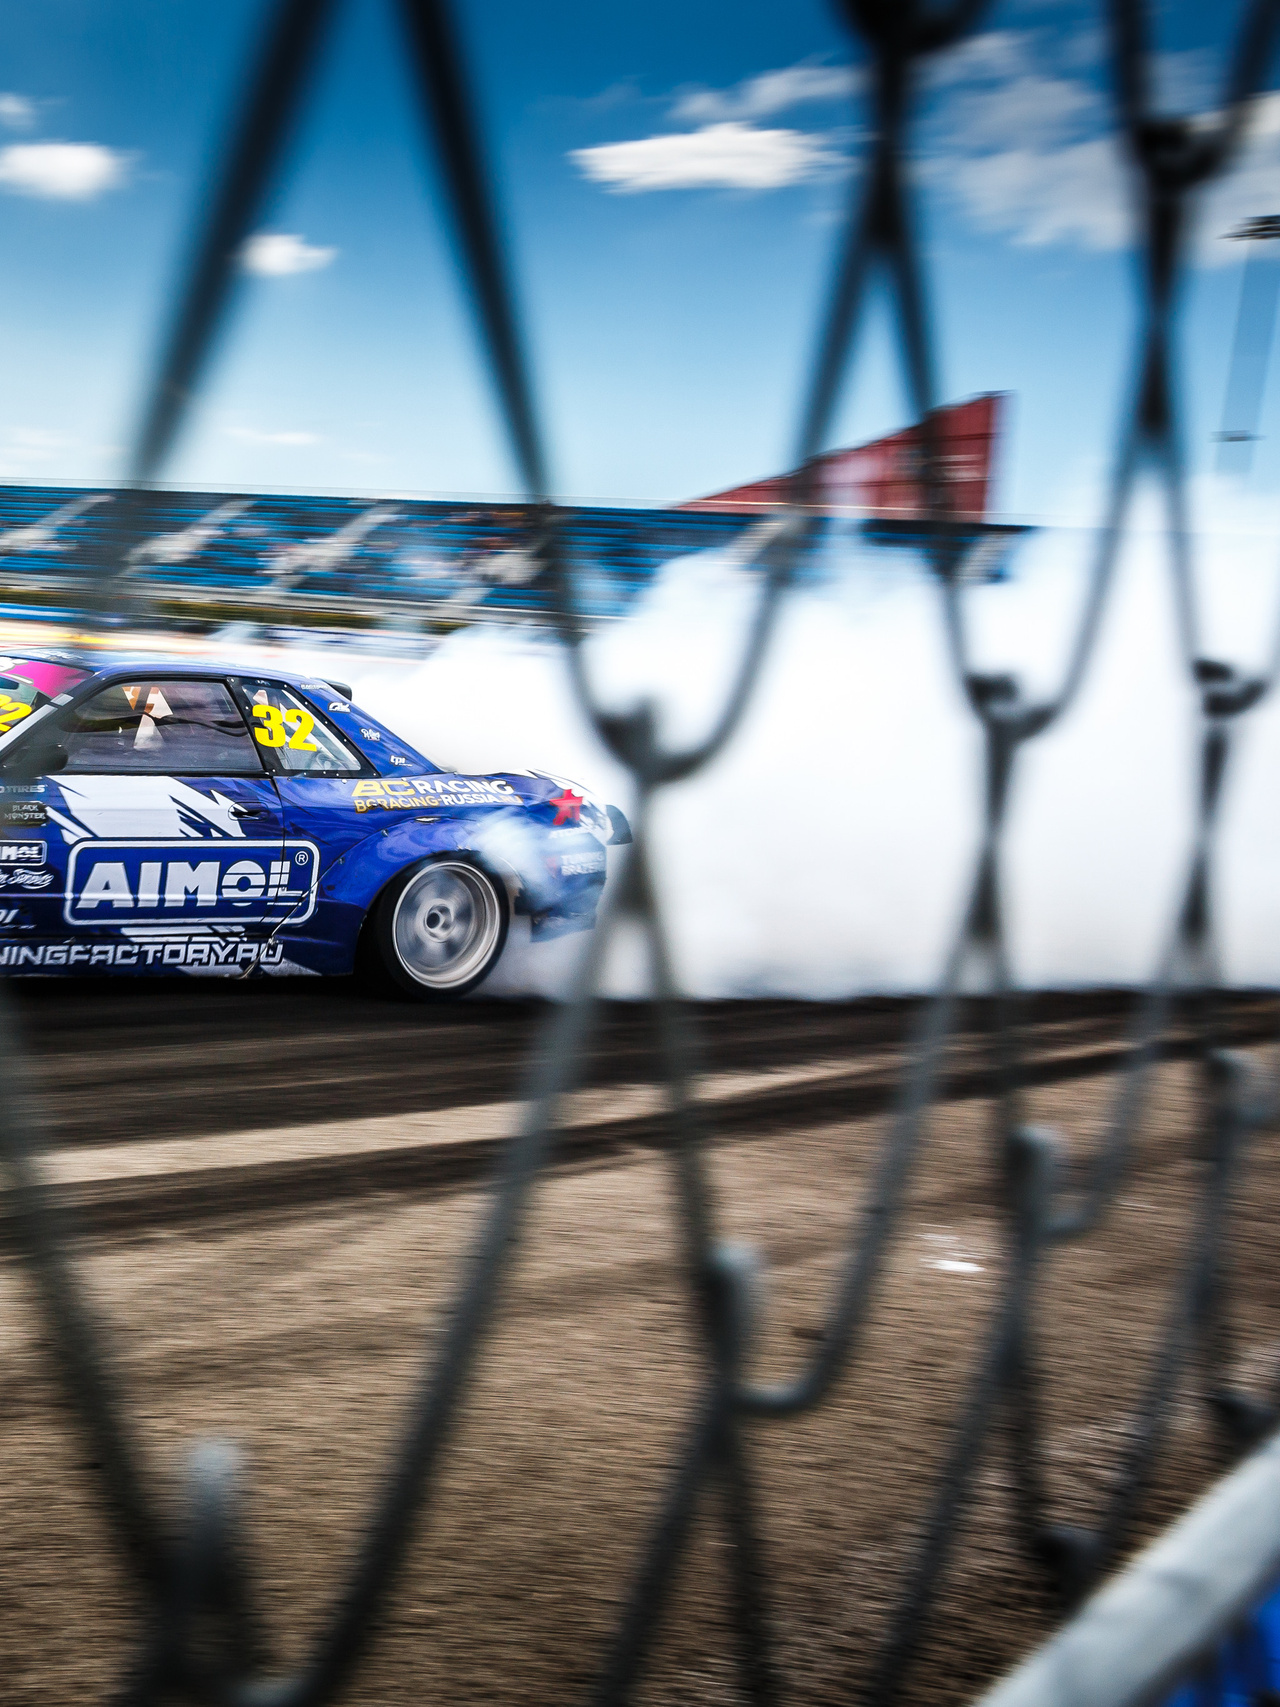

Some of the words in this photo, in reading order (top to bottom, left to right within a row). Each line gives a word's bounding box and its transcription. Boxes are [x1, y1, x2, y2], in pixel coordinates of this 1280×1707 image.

[252, 704, 317, 752] 32
[12, 784, 46, 793] TIRES
[411, 779, 515, 795] RACING
[75, 860, 303, 909] AIMOL
